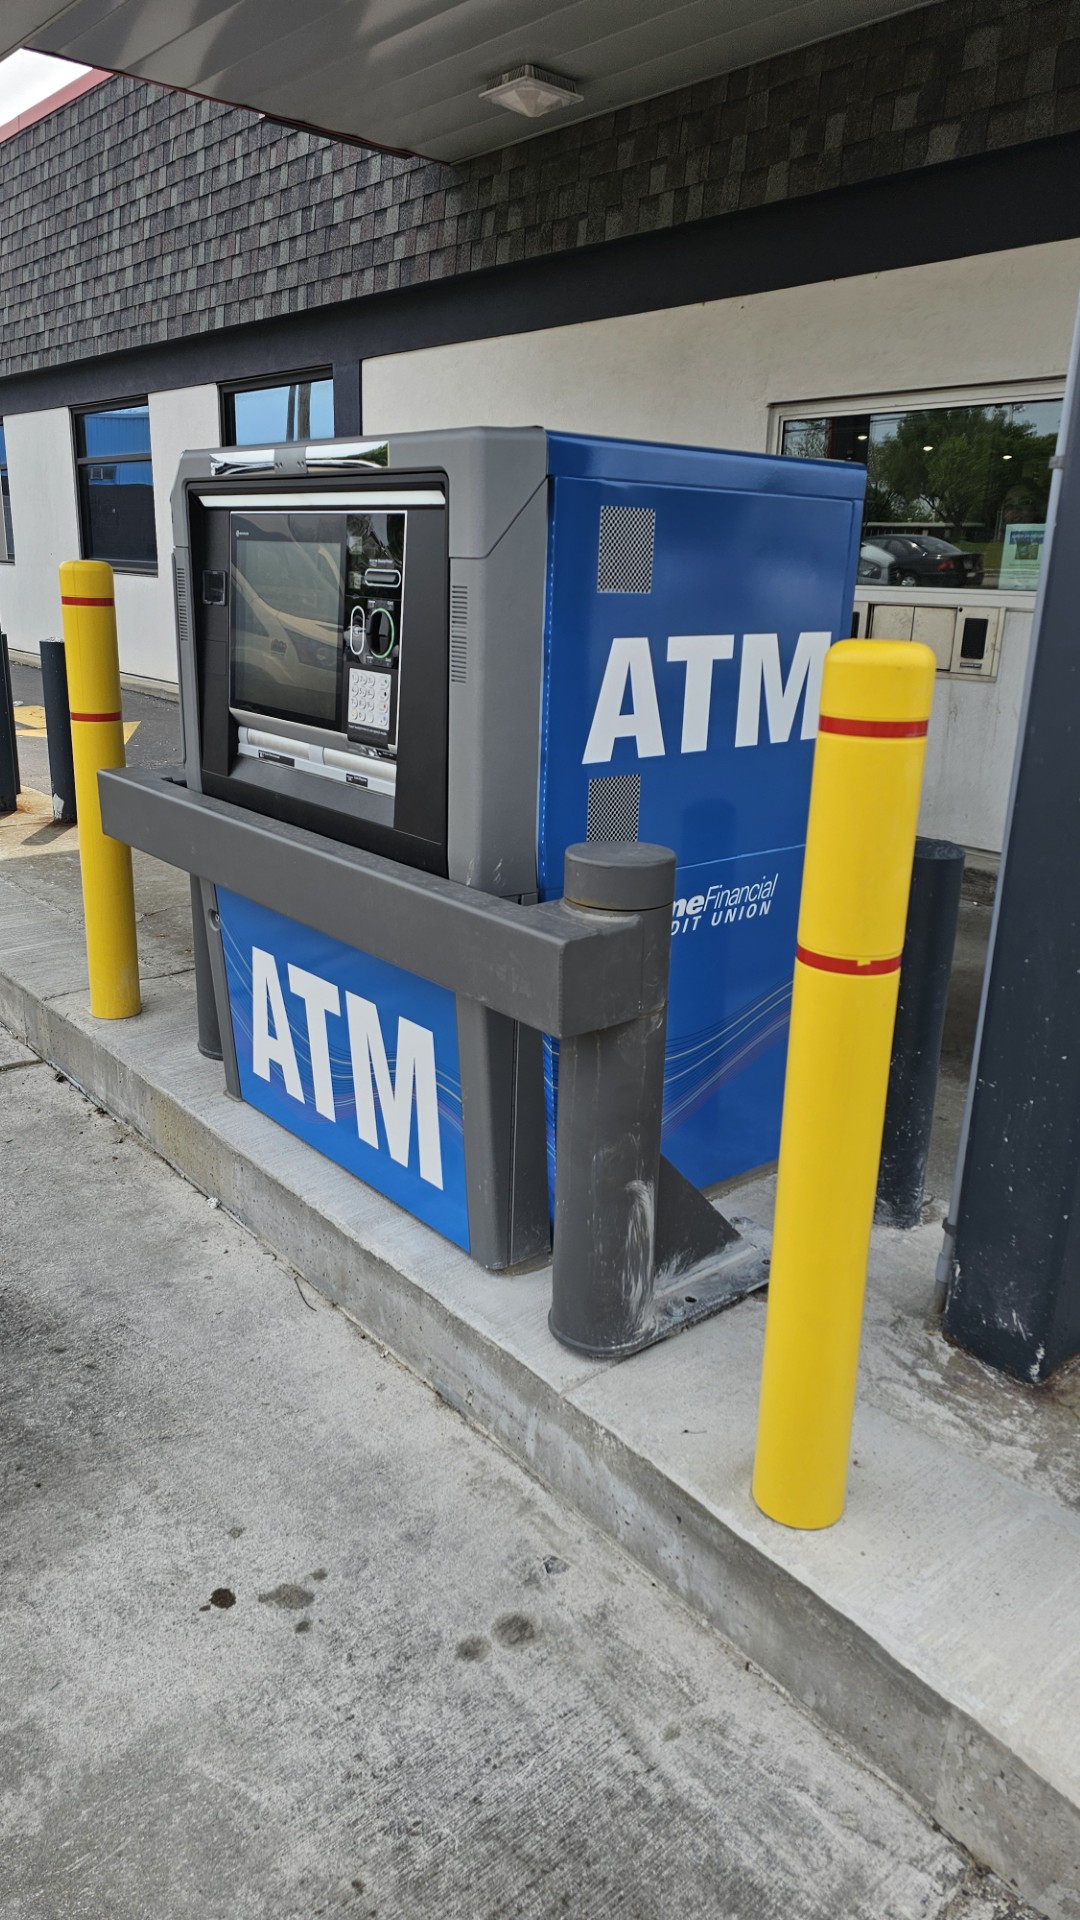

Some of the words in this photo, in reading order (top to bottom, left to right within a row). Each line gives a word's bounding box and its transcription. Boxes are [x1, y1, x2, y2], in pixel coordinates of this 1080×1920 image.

[582, 632, 831, 764] ATM
[711, 900, 772, 926] UNION
[252, 946, 443, 1191] ATM
